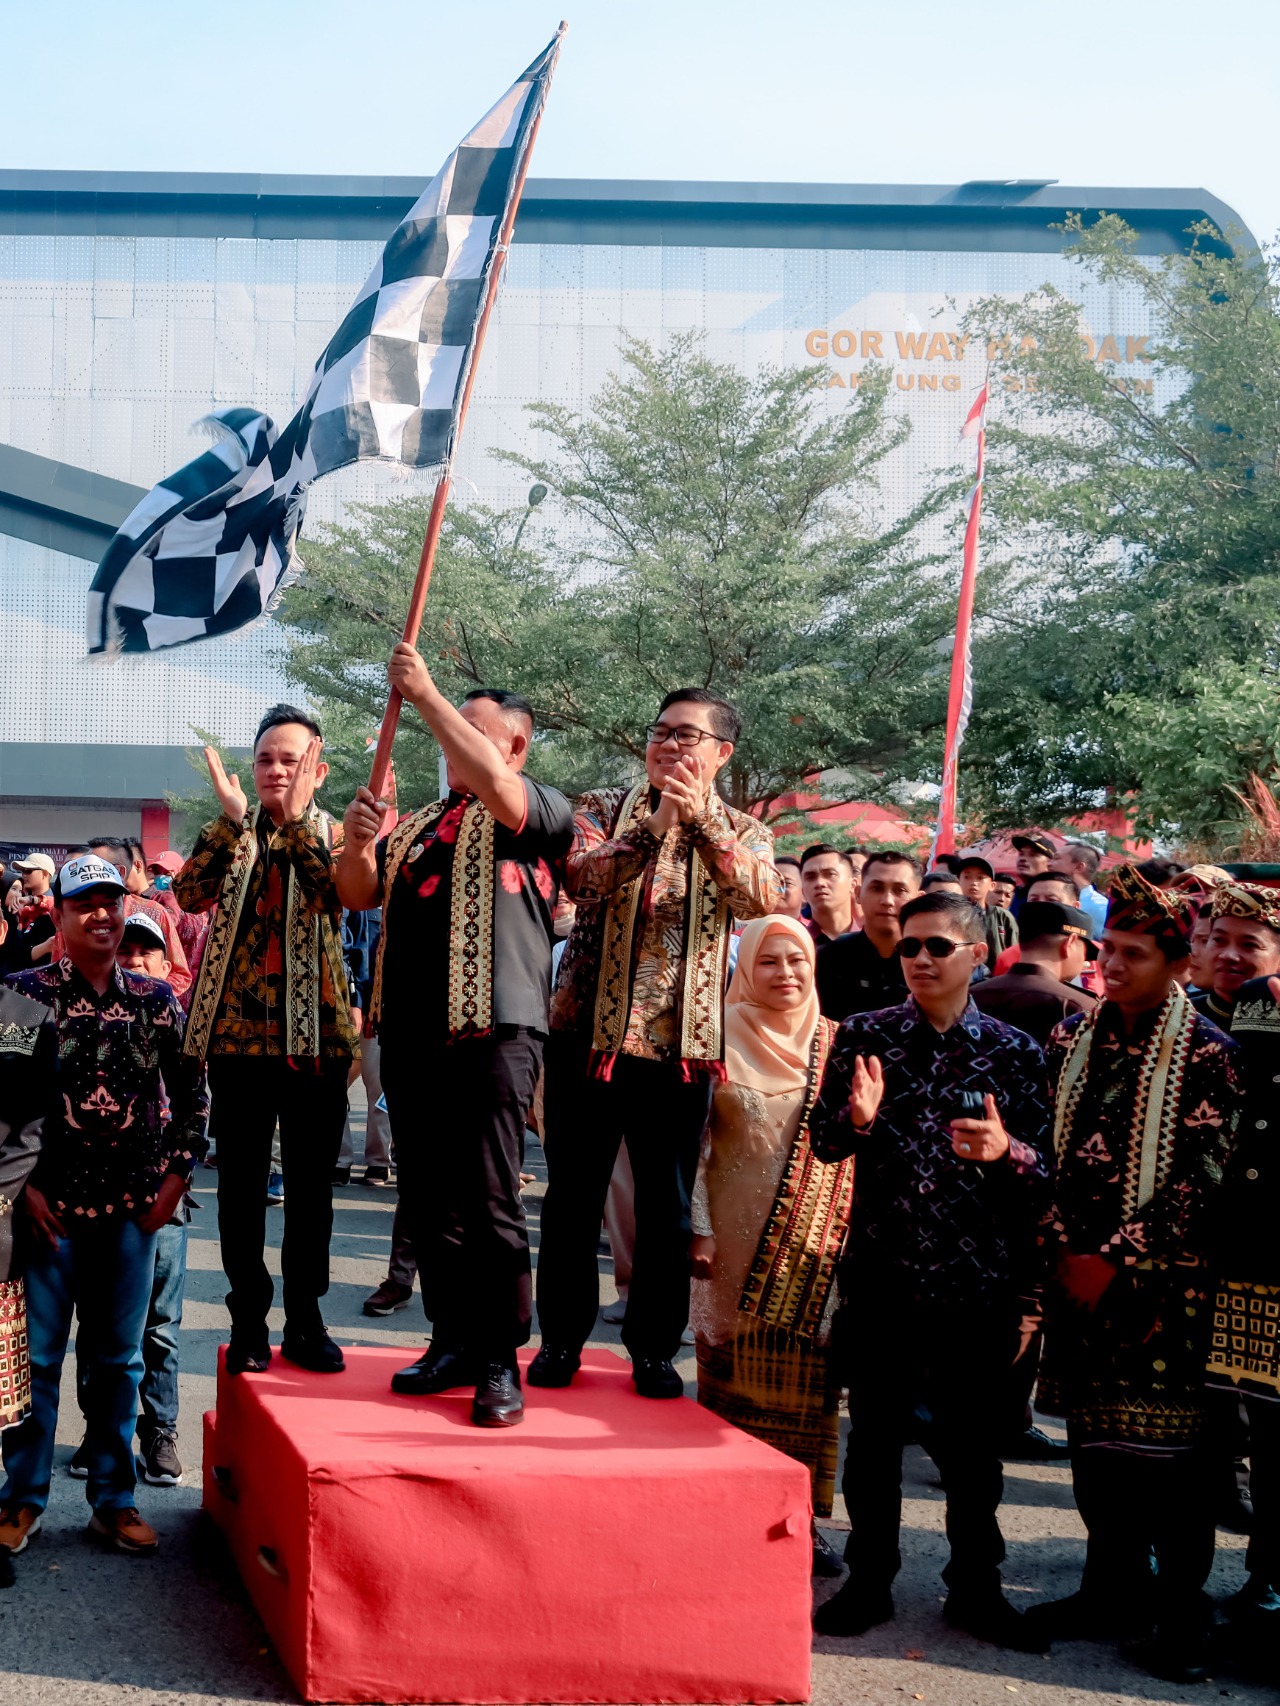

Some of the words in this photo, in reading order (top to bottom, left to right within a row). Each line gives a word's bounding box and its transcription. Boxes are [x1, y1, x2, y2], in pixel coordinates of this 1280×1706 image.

[805, 330, 884, 359] GOR
[895, 331, 969, 361] WAY
[806, 372, 962, 391] AUNG
[70, 864, 116, 878] SATGAS
